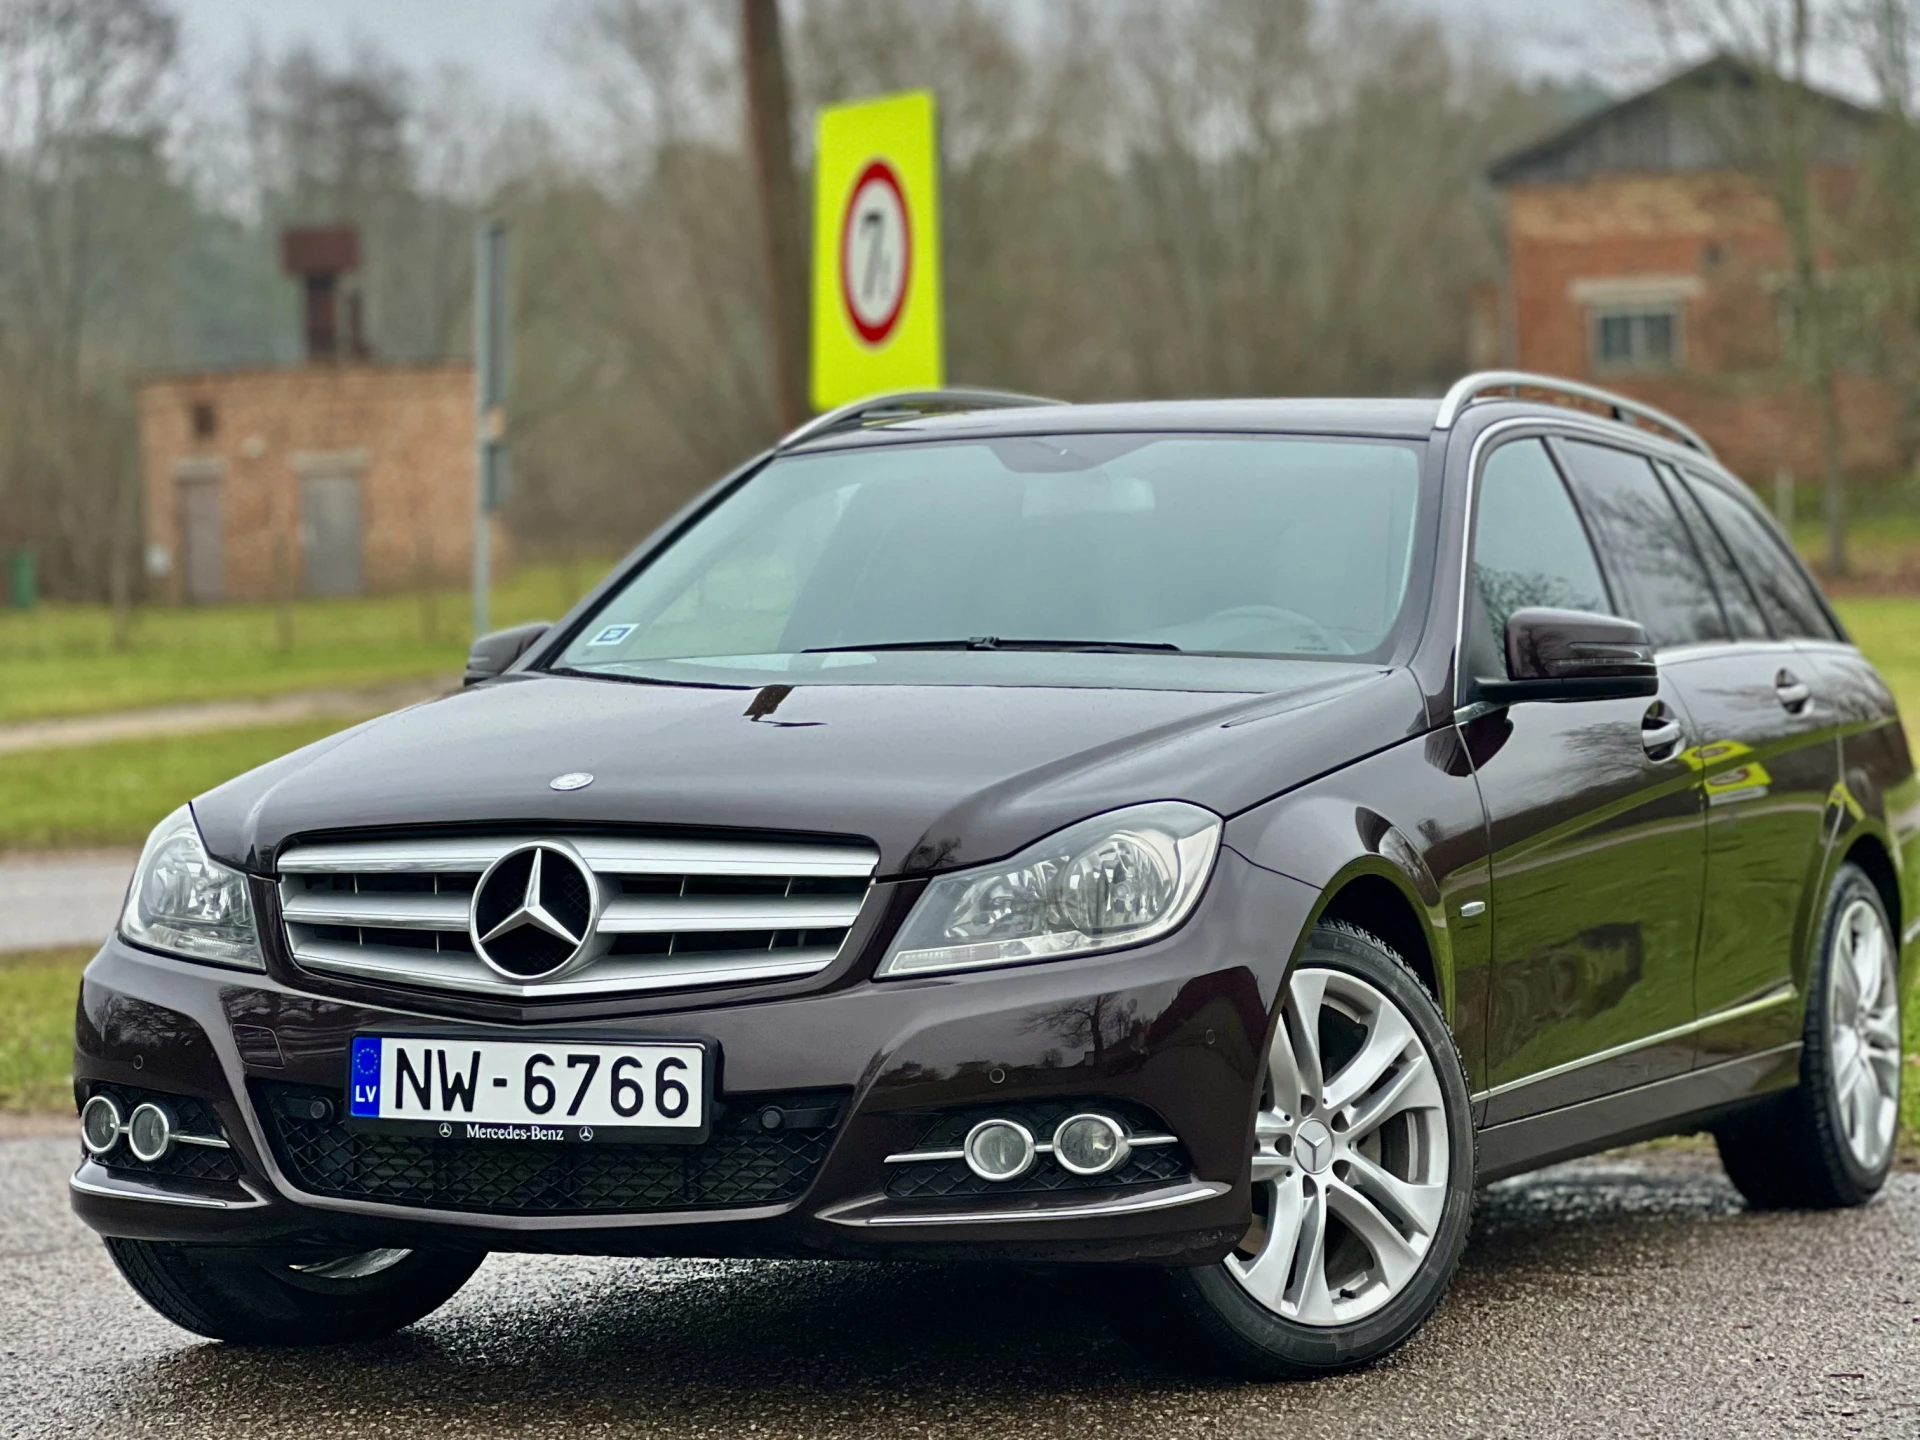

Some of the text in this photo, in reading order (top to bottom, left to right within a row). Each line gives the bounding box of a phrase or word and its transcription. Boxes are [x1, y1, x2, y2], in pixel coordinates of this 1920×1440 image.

[395, 1047, 689, 1119] NW-6766
[355, 1085, 377, 1102] LV
[466, 1124, 564, 1140] Mercedes-Benz
